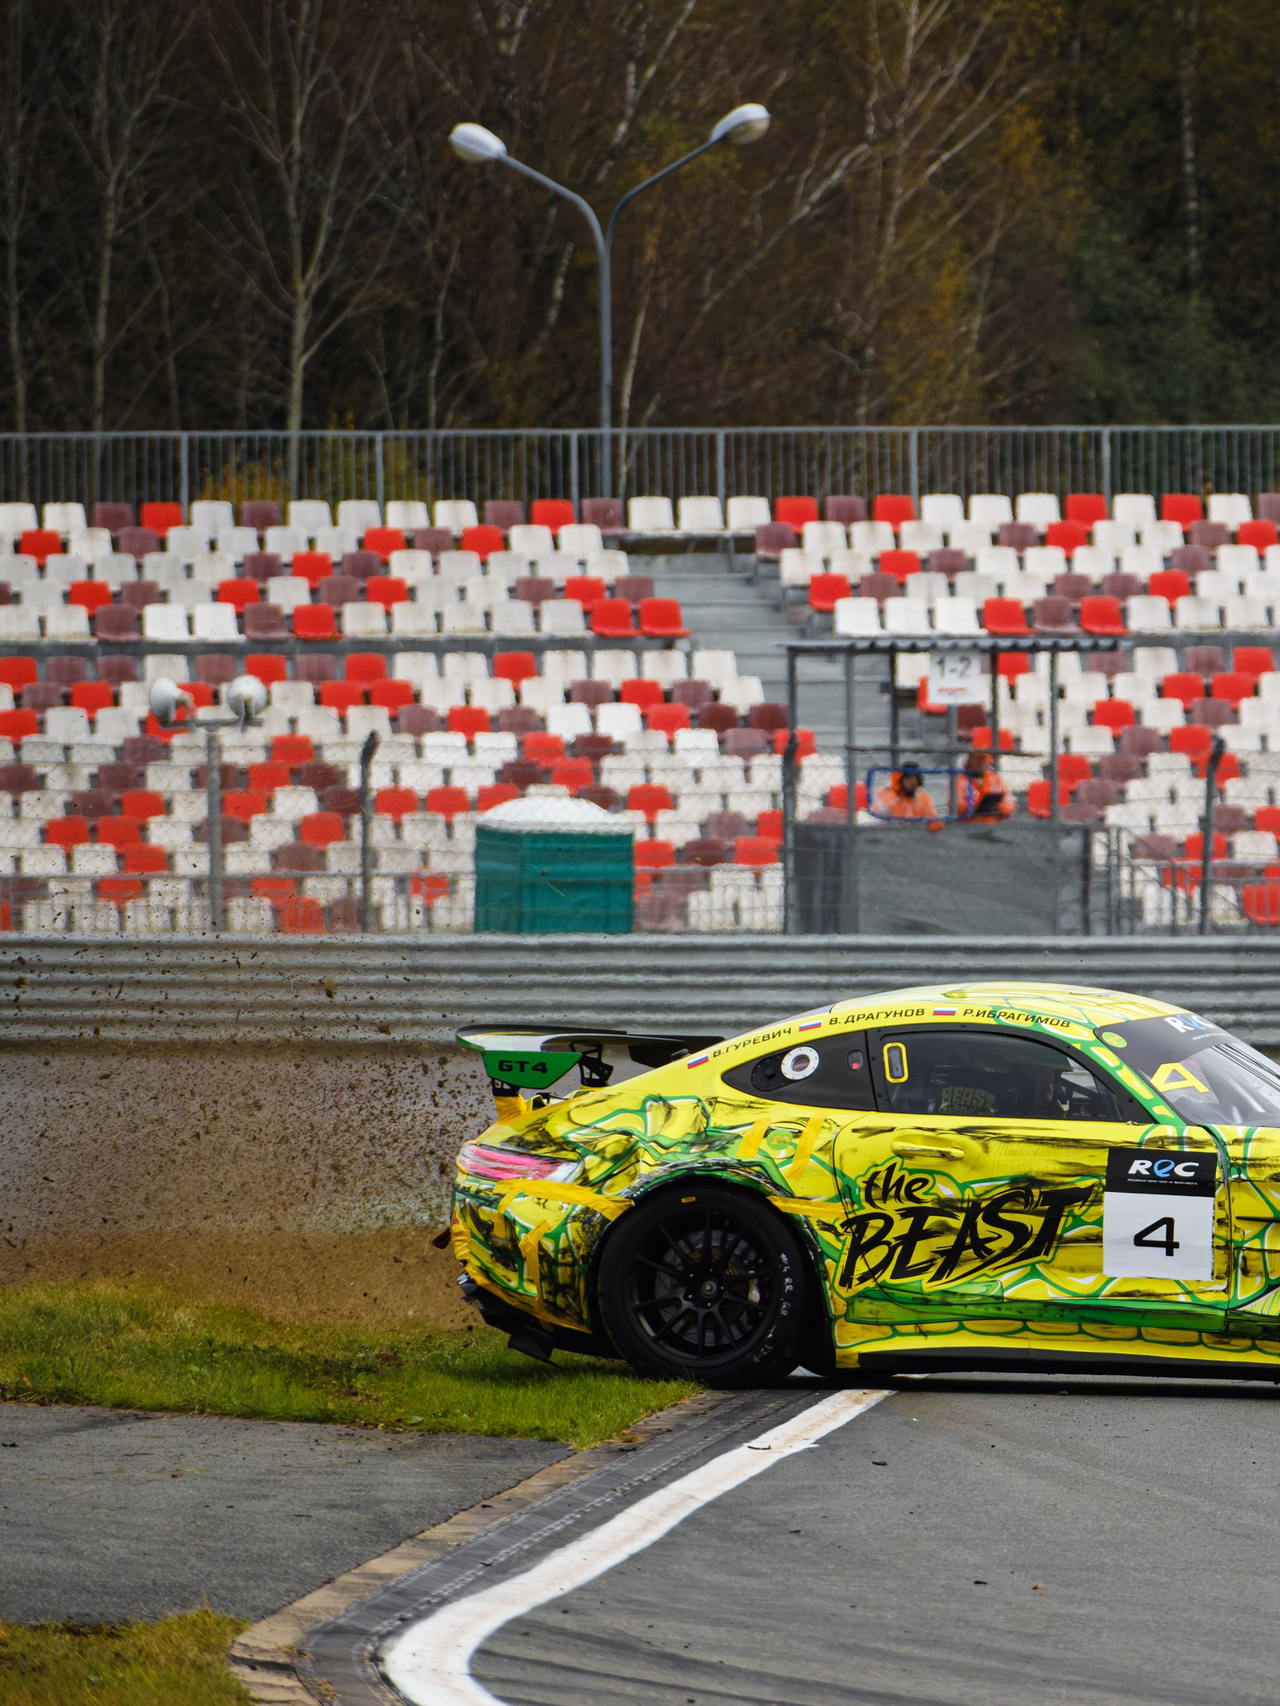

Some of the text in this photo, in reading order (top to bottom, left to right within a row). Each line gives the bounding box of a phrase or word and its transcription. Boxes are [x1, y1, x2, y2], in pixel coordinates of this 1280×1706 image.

[937, 656, 971, 678] 1-2
[963, 1009, 1071, 1028] Р.ИБРАГИМОВ
[713, 1027, 792, 1058] В.ГУРЕВИЧ
[498, 1060, 548, 1074] GT4
[1150, 1062, 1210, 1093] 4
[863, 1161, 933, 1210] the
[839, 1182, 1097, 1291] BEAST
[1133, 1217, 1180, 1257] 4
